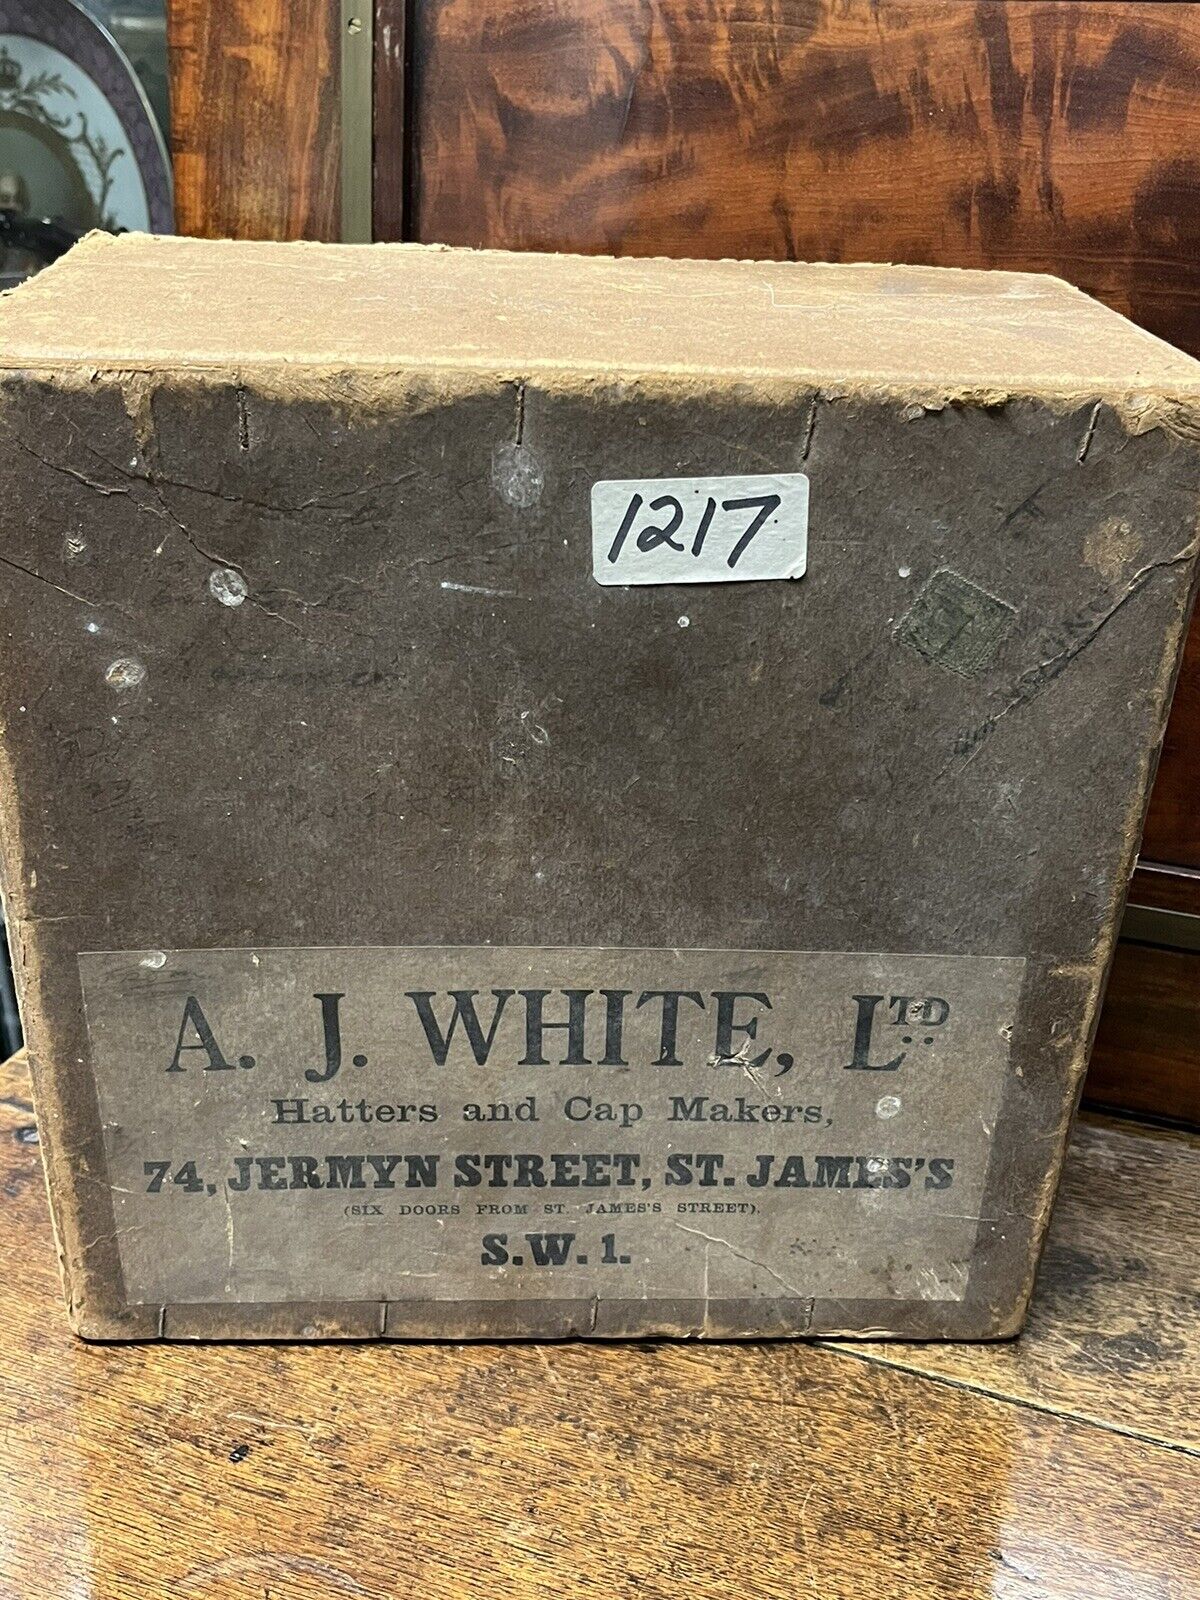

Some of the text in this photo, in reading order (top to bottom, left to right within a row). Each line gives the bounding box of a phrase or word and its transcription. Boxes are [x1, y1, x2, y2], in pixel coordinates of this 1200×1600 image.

[607, 493, 781, 569] 1217
[165, 995, 256, 1073] A.
[304, 992, 368, 1083] J.
[404, 988, 794, 1077] WHITE,
[270, 1096, 834, 1129] Hatters and Cap Makers,
[143, 1153, 955, 1197] 74, JERMYN STREET, ST. JAMES'S
[343, 1204, 385, 1217] (SIX
[398, 1203, 461, 1216] DOORS
[475, 1203, 529, 1216] FROM
[585, 1202, 662, 1215] JAMES'S
